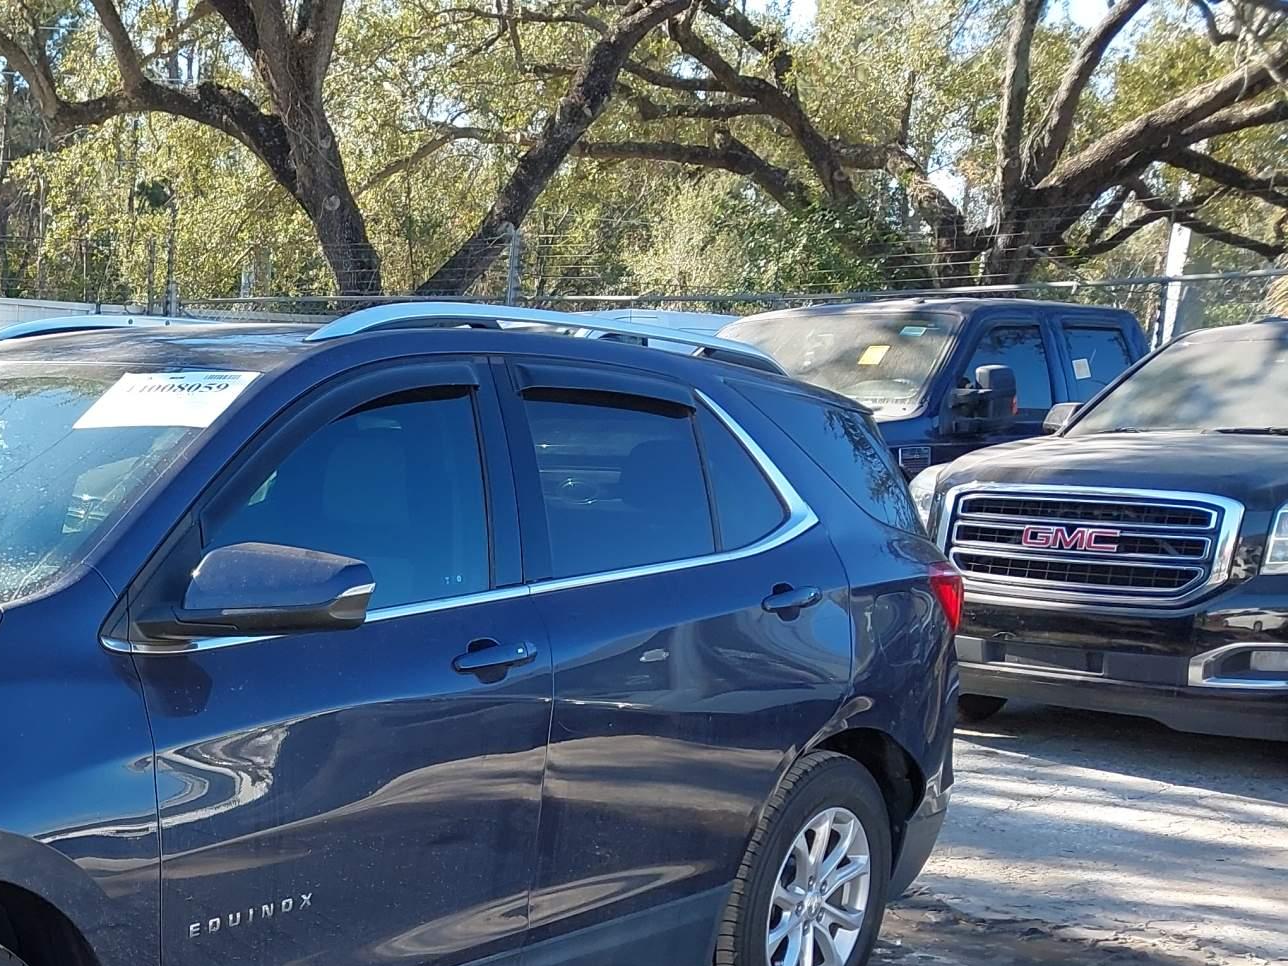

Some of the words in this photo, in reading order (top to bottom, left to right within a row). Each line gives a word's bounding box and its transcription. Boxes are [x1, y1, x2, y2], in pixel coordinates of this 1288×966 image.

[125, 382, 231, 393] 008059
[1022, 525, 1121, 552] GMC
[189, 892, 313, 938] EQUINOX
